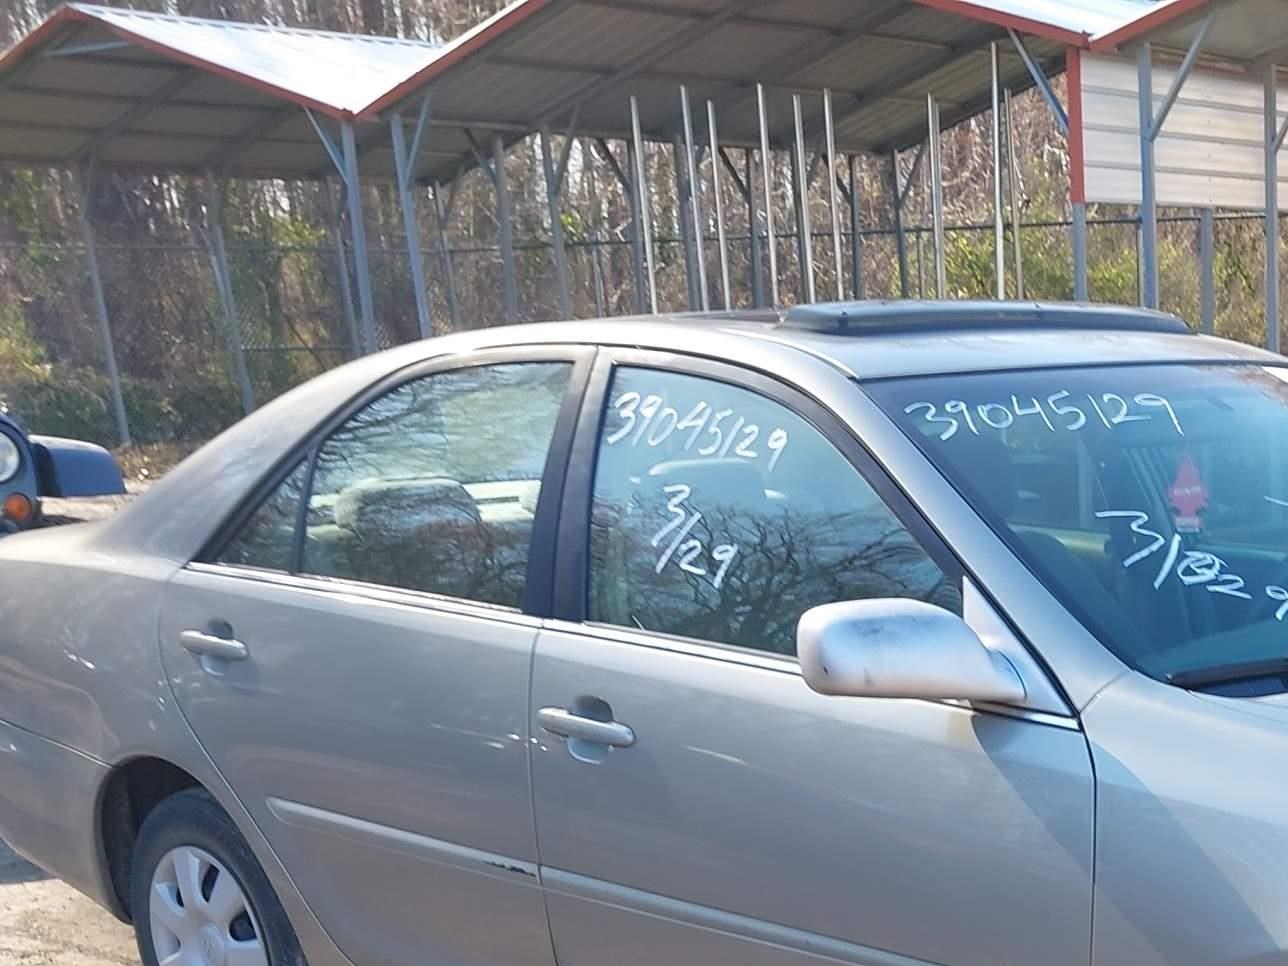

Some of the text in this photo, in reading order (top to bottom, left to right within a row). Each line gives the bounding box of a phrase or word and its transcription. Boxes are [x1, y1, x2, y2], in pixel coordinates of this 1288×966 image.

[606, 391, 789, 473] 39045129
[904, 390, 1185, 441] 39045129
[650, 483, 740, 589] 3/29
